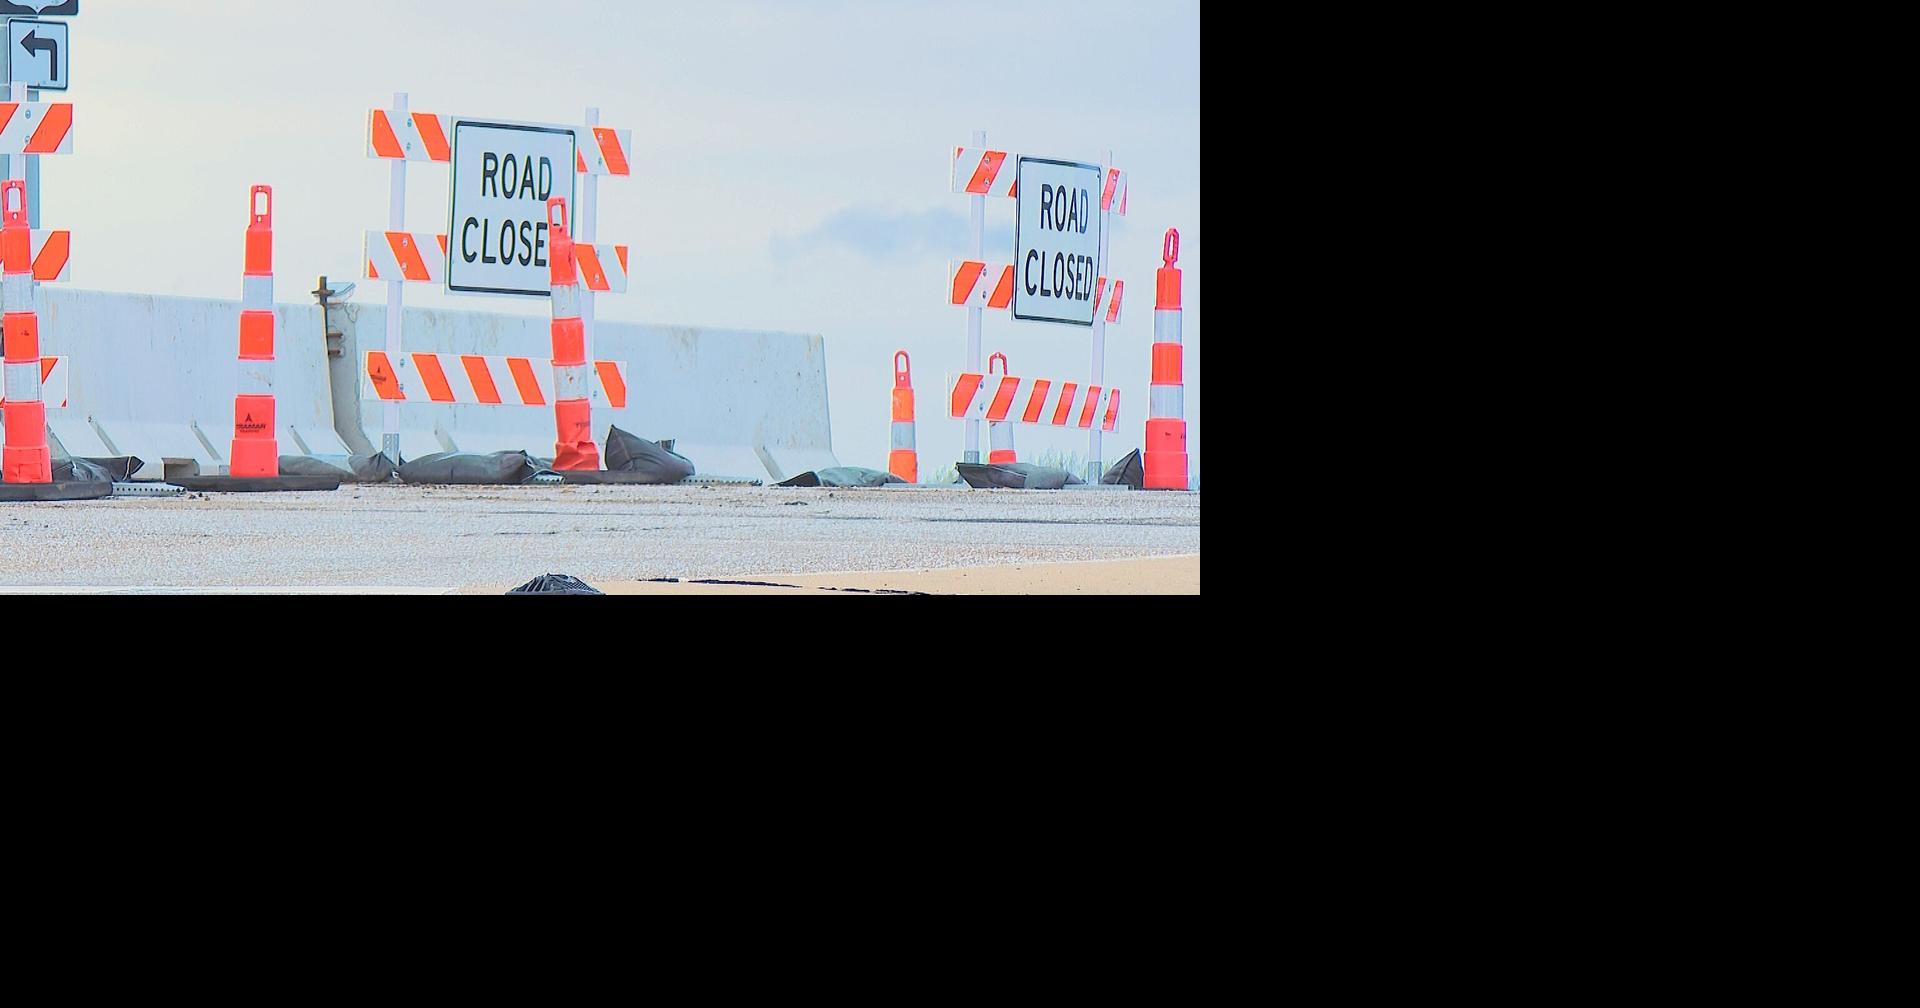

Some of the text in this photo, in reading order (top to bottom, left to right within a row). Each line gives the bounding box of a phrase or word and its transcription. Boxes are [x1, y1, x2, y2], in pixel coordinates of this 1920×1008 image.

[481, 151, 552, 201] ROAD
[1040, 183, 1089, 234] ROAD
[461, 216, 560, 268] CLOSE
[1024, 248, 1094, 301] CLOSED
